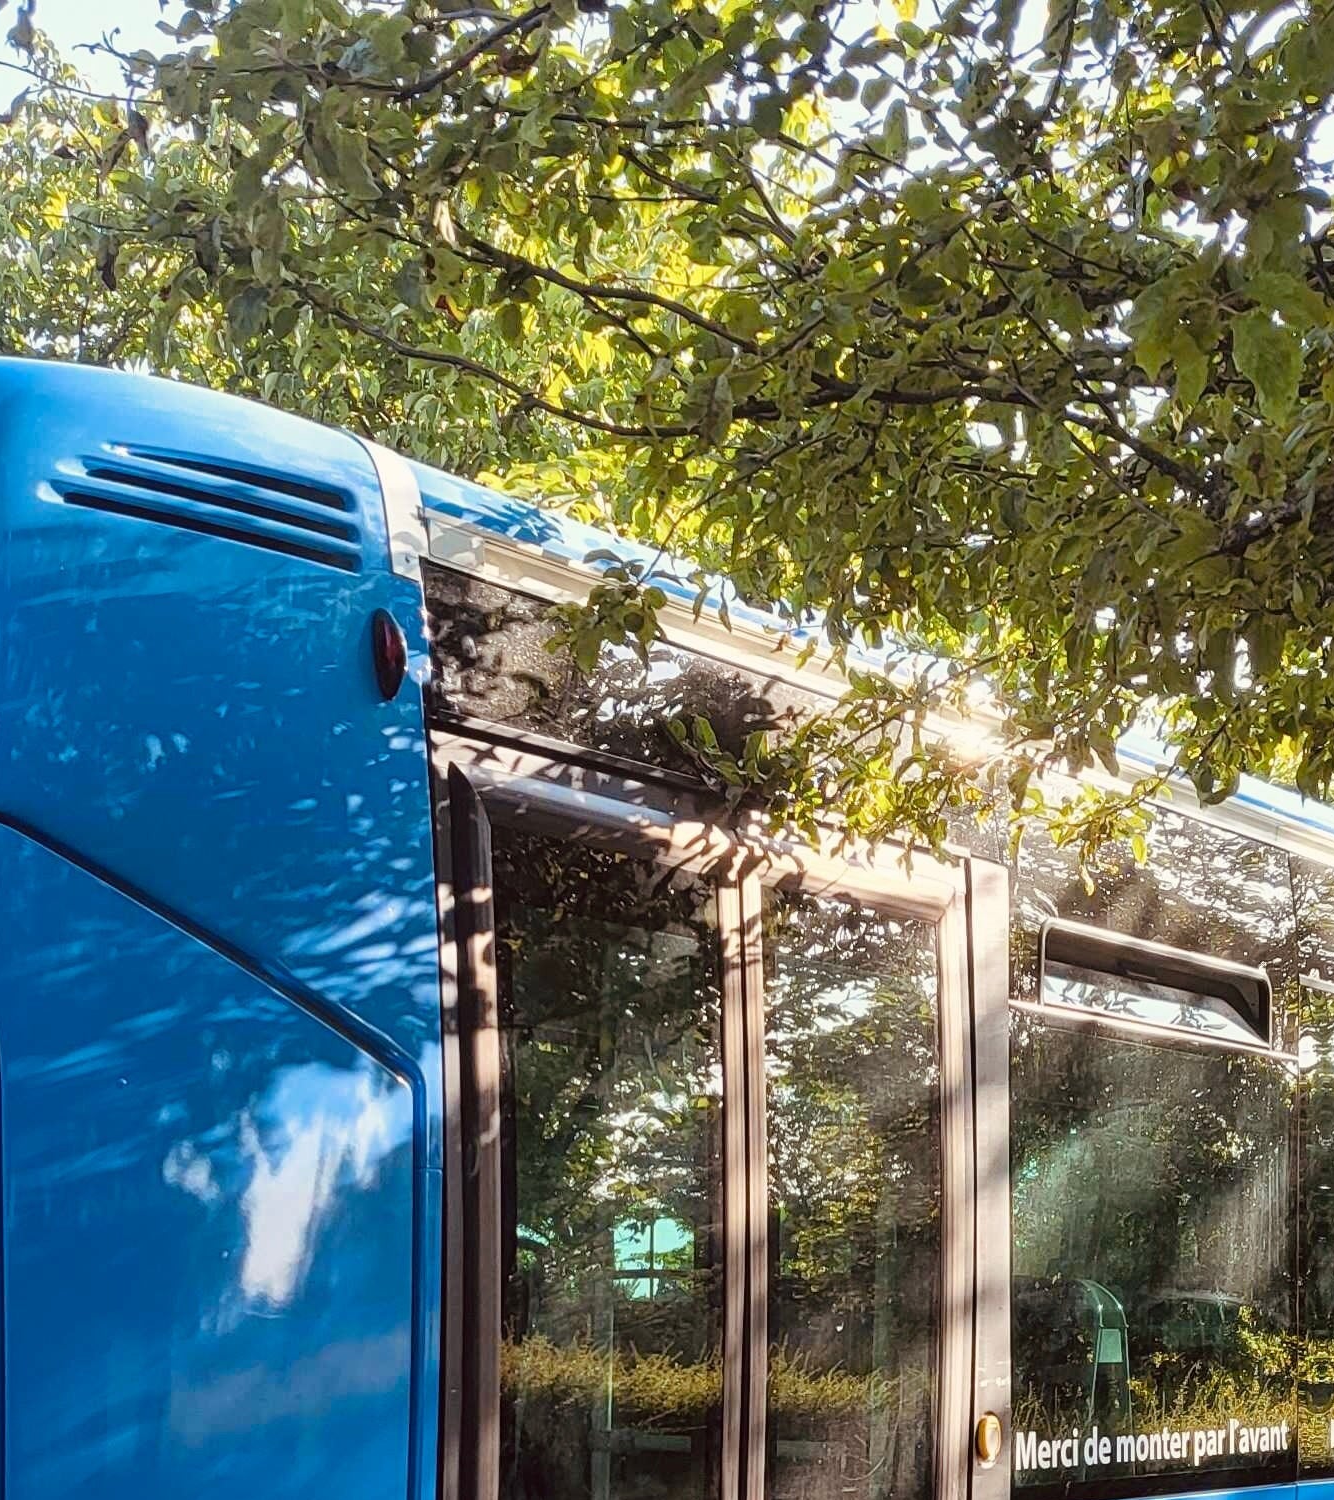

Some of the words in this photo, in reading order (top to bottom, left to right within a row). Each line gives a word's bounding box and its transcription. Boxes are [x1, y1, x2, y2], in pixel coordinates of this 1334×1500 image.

[1015, 1428, 1079, 1471] Merci
[1084, 1426, 1112, 1466] de
[1117, 1427, 1191, 1462] monter
[1194, 1429, 1226, 1466] par
[1229, 1419, 1289, 1454] l'avant
